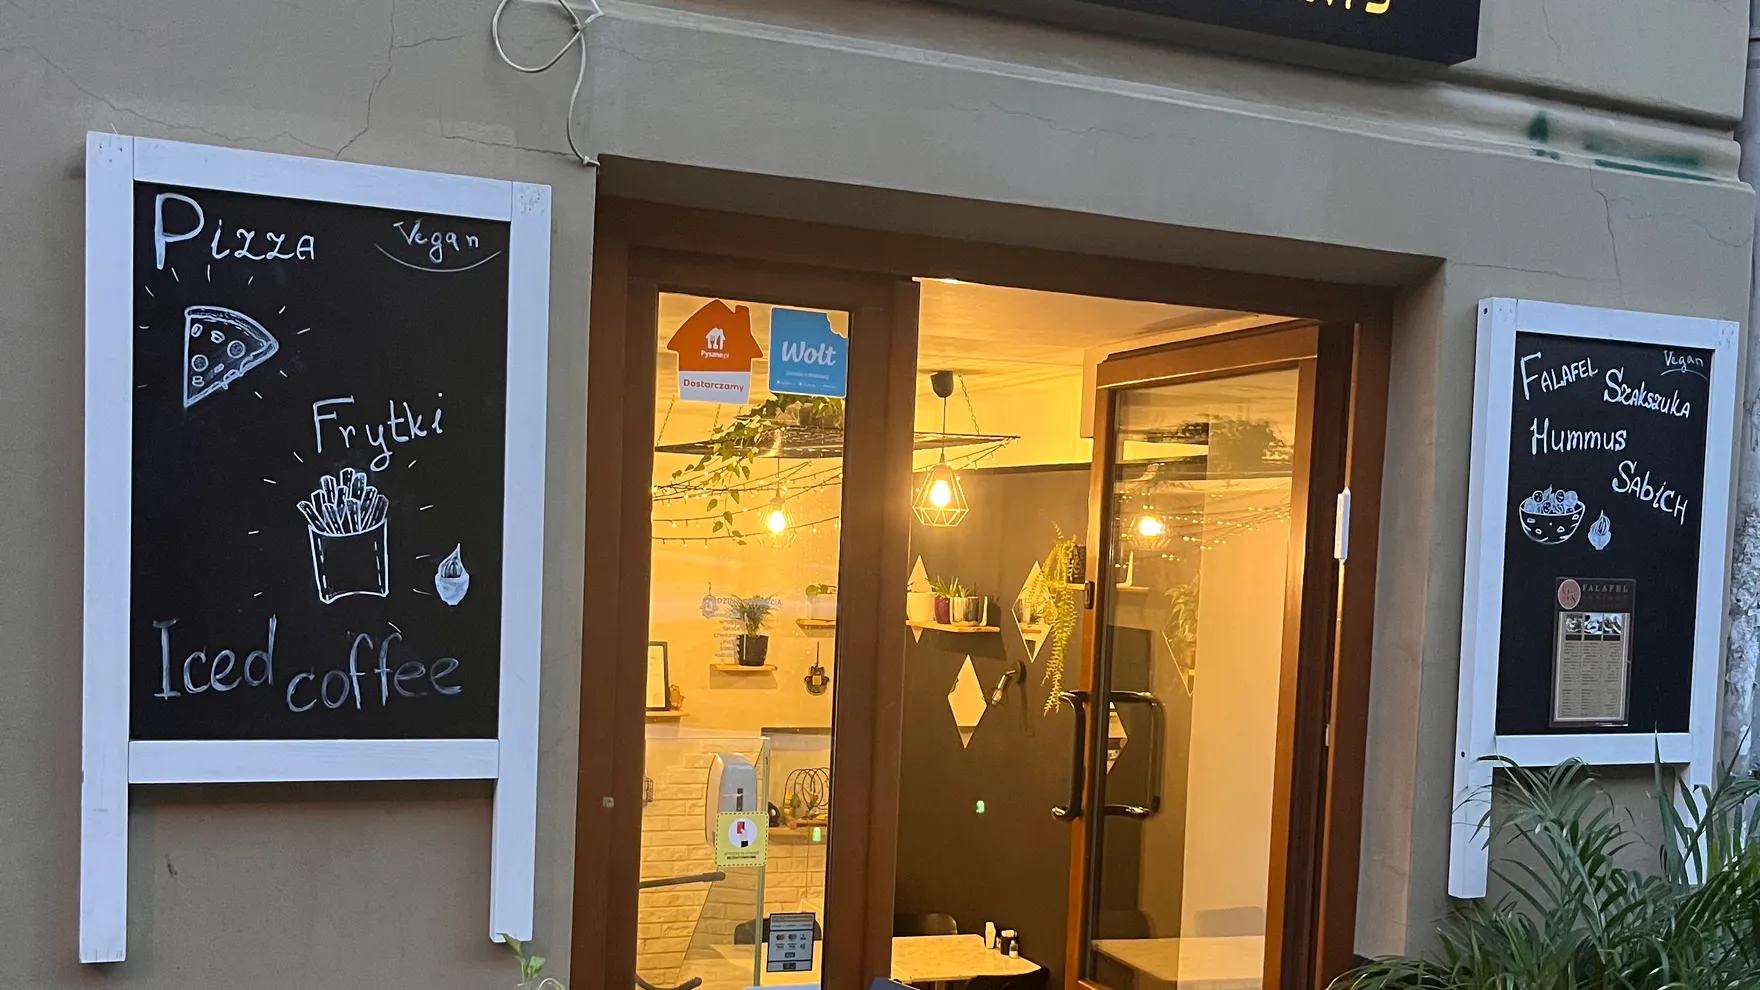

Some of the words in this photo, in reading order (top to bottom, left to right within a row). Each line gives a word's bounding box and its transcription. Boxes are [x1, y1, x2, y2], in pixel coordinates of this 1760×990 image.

[393, 219, 480, 264] Vegan
[781, 341, 837, 366] Wolt
[1663, 350, 1704, 371] Vegan
[683, 378, 745, 392] Dostarczamy
[312, 393, 444, 469] Frytki
[1582, 584, 1628, 593] FALAFEL
[152, 614, 277, 700] Iced
[287, 631, 464, 713] coffee
